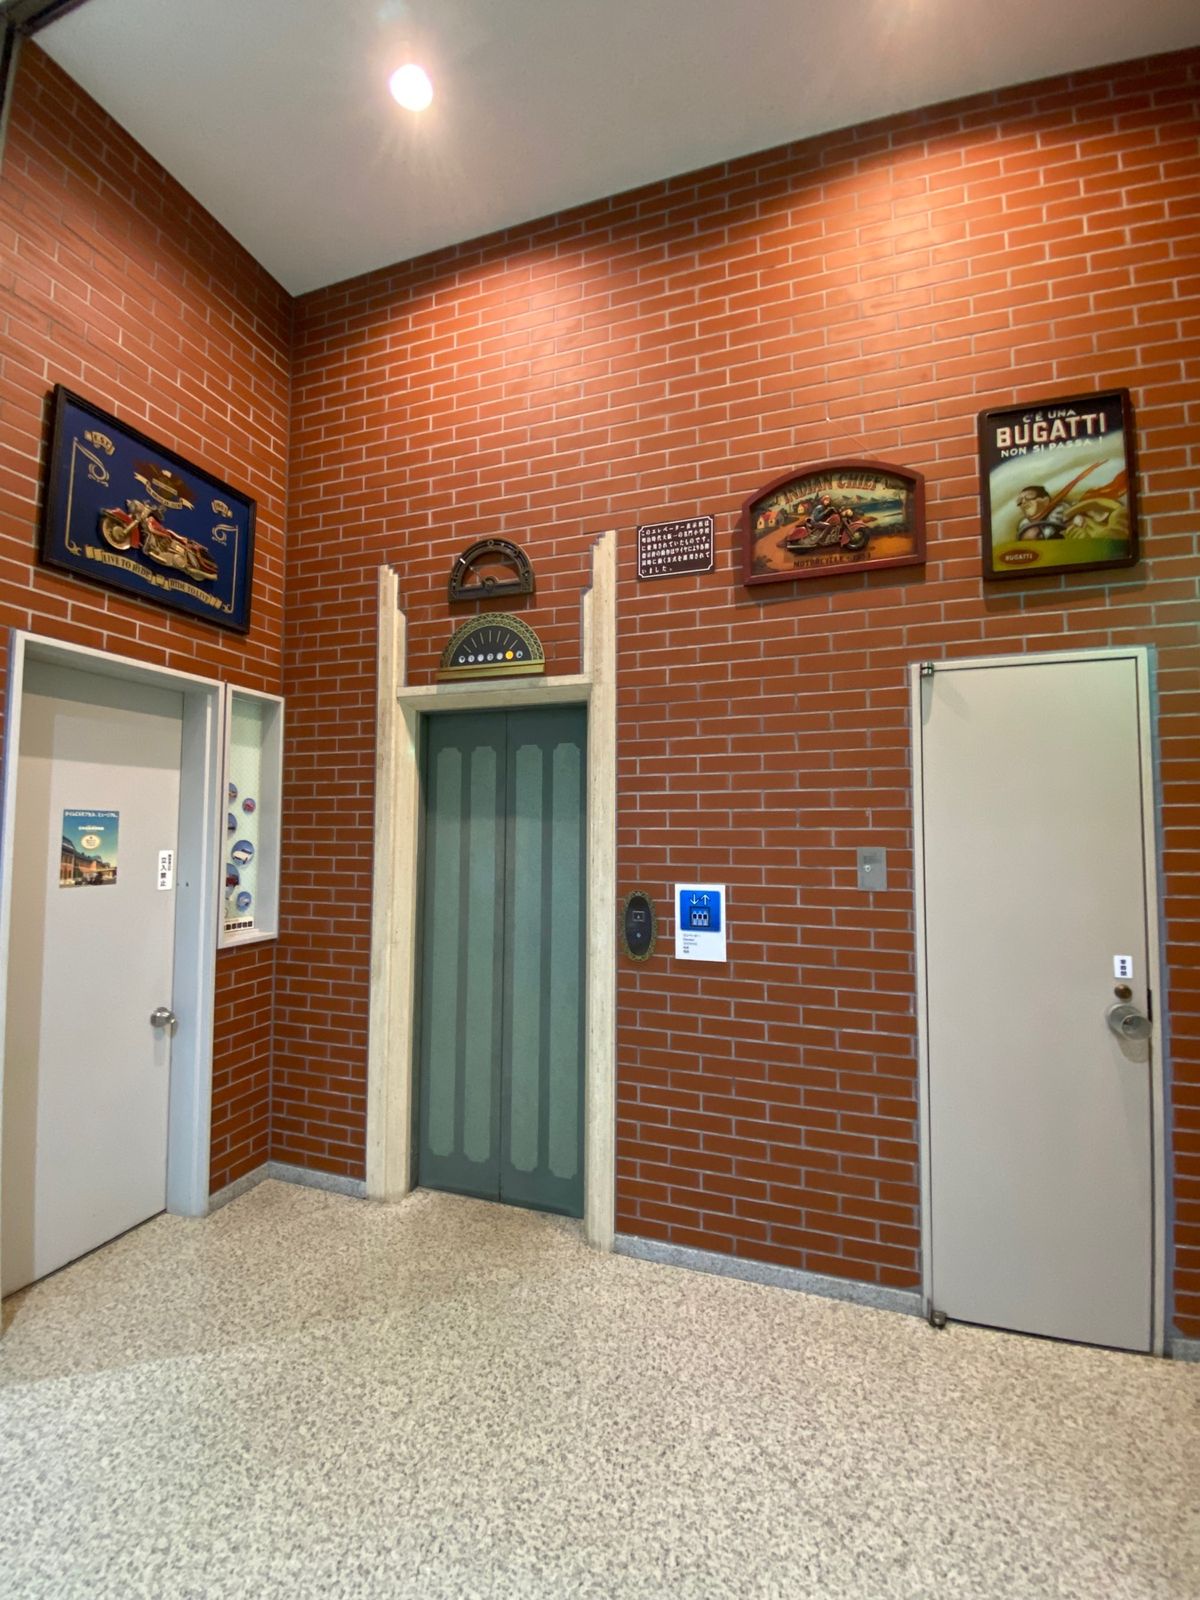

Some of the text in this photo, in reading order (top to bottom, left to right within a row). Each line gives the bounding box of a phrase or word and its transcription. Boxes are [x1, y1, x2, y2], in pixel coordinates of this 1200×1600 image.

[1048, 408, 1076, 419] UNA
[996, 412, 1107, 448] BUGATTI
[1001, 446, 1027, 458] NON
[1033, 443, 1044, 452] SI
[1049, 438, 1093, 451] PASSA
[103, 552, 119, 565] LIVE
[122, 558, 132, 569] TO
[1005, 553, 1033, 562] BUGATTI
